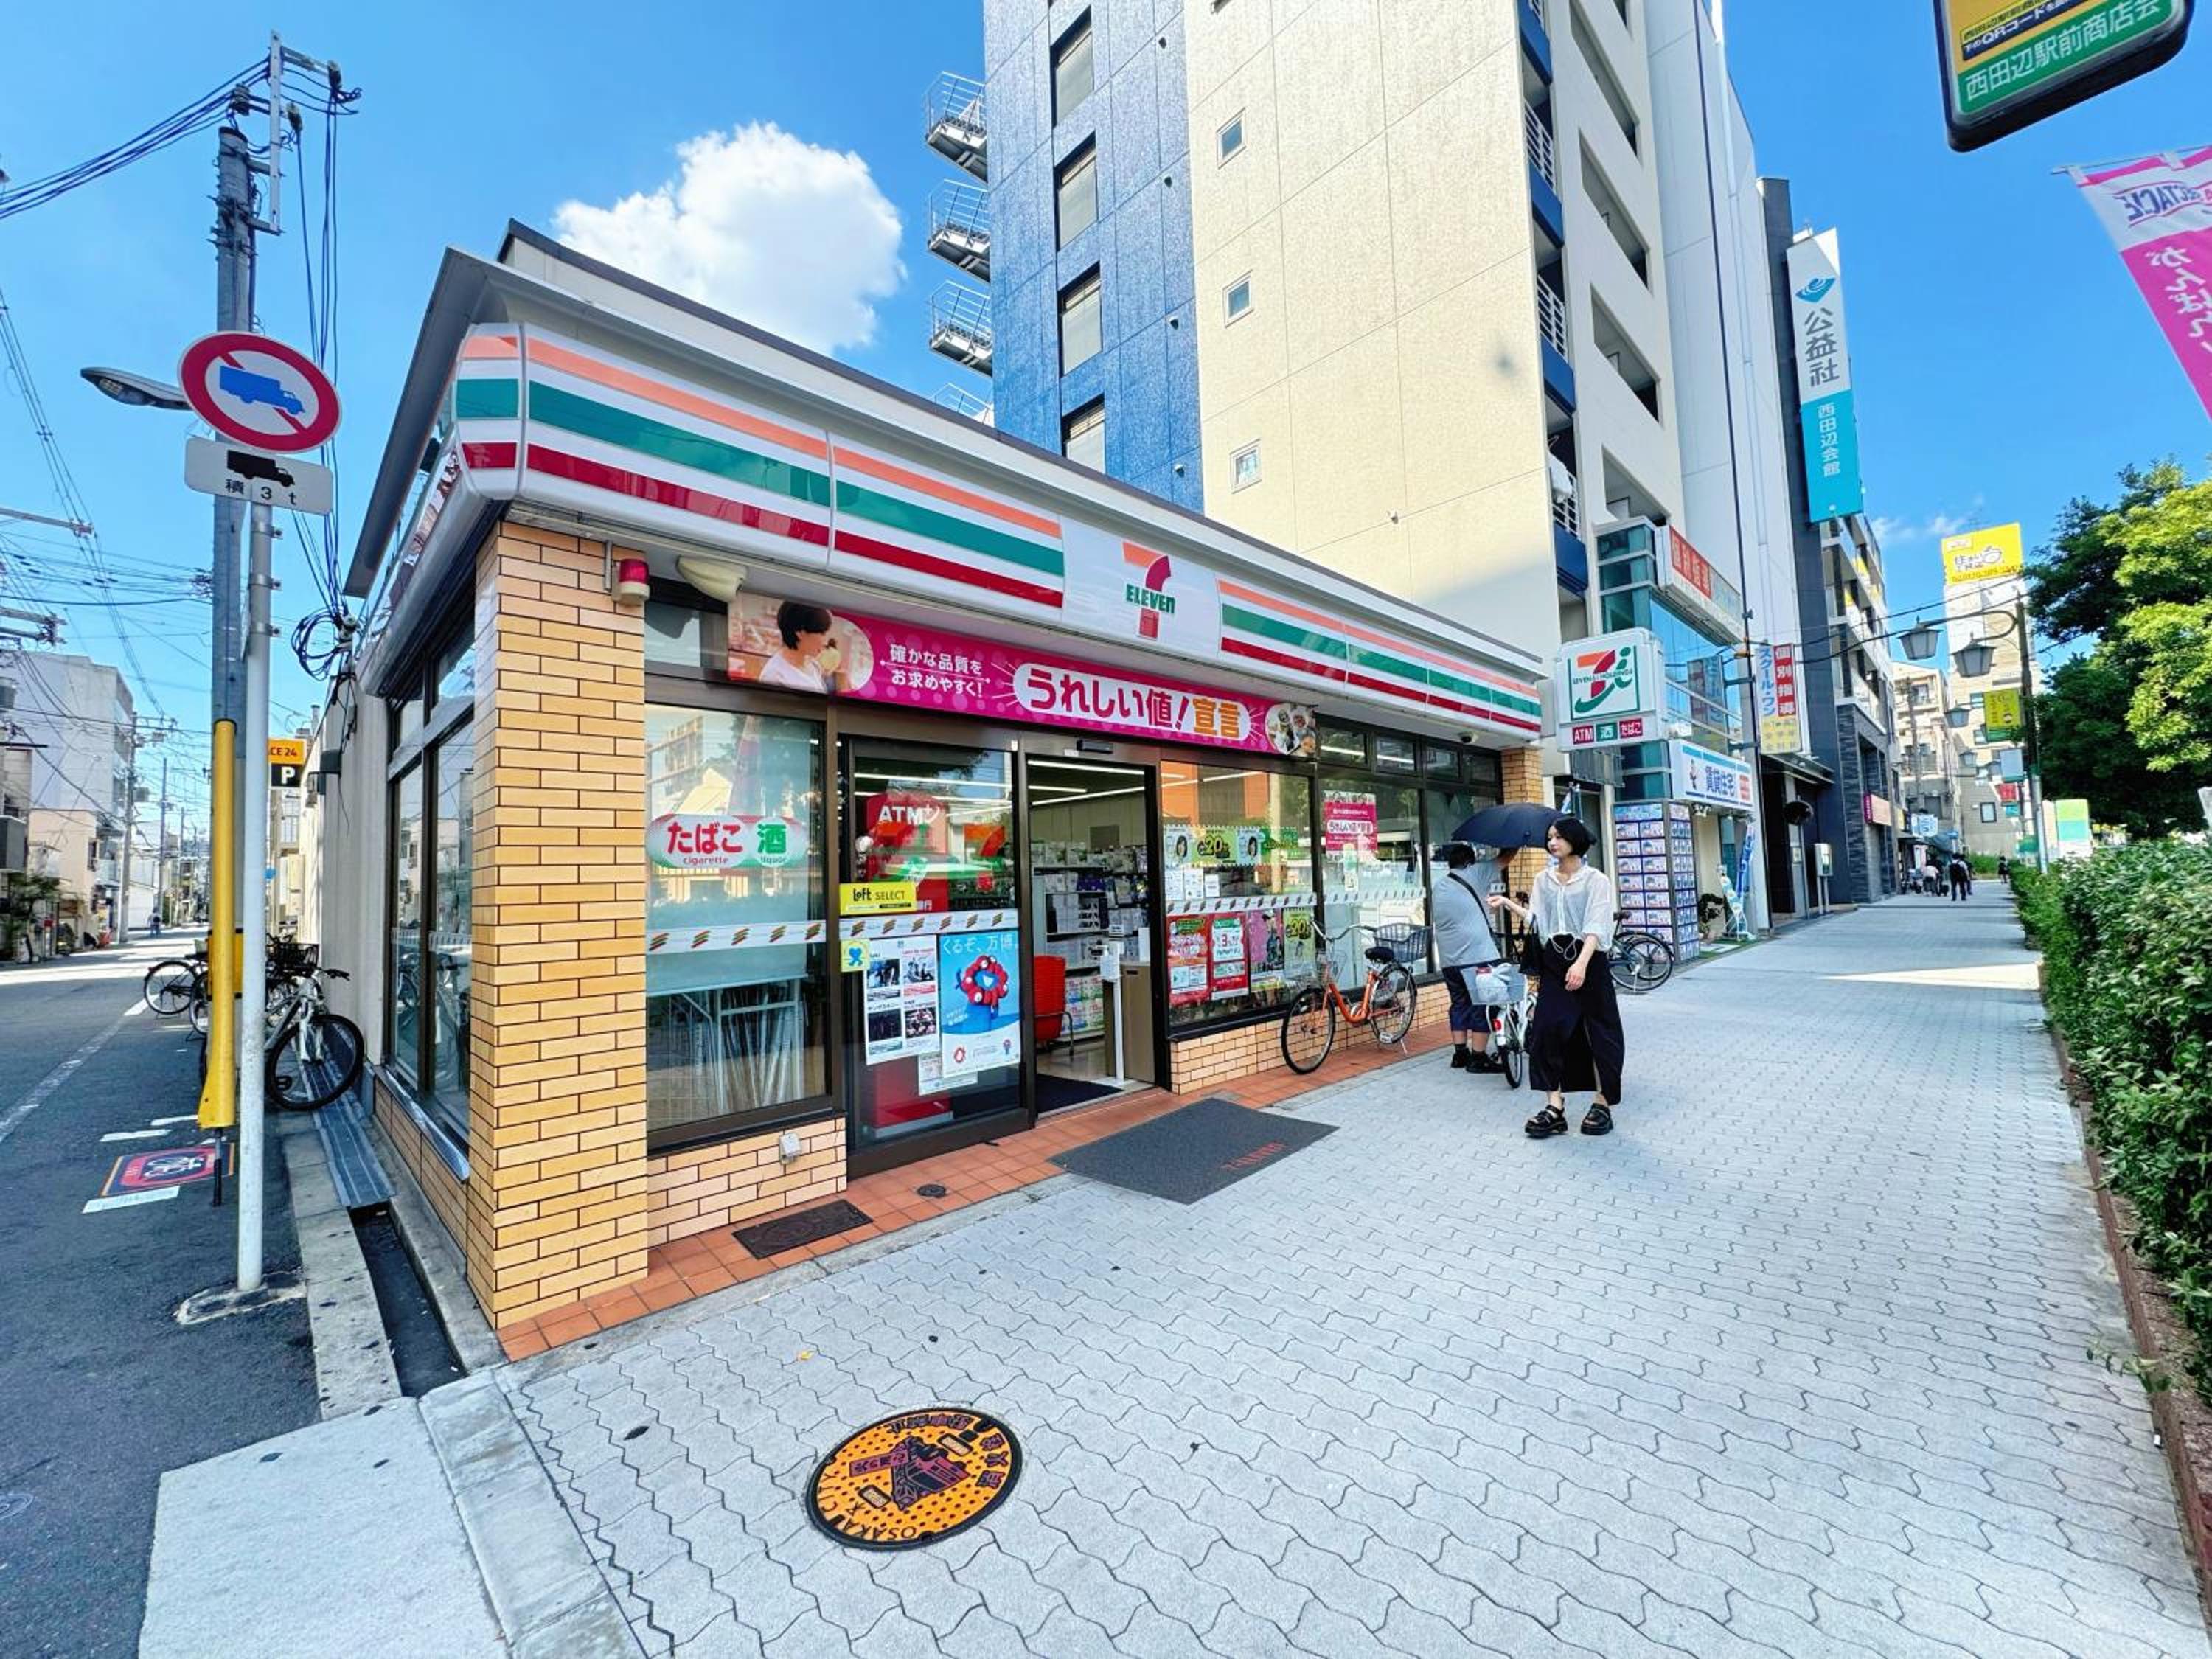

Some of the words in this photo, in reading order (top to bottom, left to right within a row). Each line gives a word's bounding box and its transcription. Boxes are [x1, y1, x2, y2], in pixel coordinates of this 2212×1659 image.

[1965, 0, 2160, 102] 西田辺駅前商店会
[1804, 307, 1840, 386] 公益社
[1818, 403, 1841, 477] 西田辺会館
[260, 486, 272, 500] 3
[288, 492, 296, 505] t
[890, 644, 981, 675] 確かな品質を
[891, 669, 982, 698] お求めやすく!
[1574, 728, 1593, 742] ATM
[1621, 721, 1641, 735] たばこ
[281, 766, 296, 785] P
[667, 821, 743, 854] たばこ
[757, 824, 787, 855] 酒
[683, 855, 729, 865] cigarette
[875, 890, 905, 900] SELECT
[818, 1473, 838, 1512] CITY
[841, 1522, 917, 1541] OSAKA
